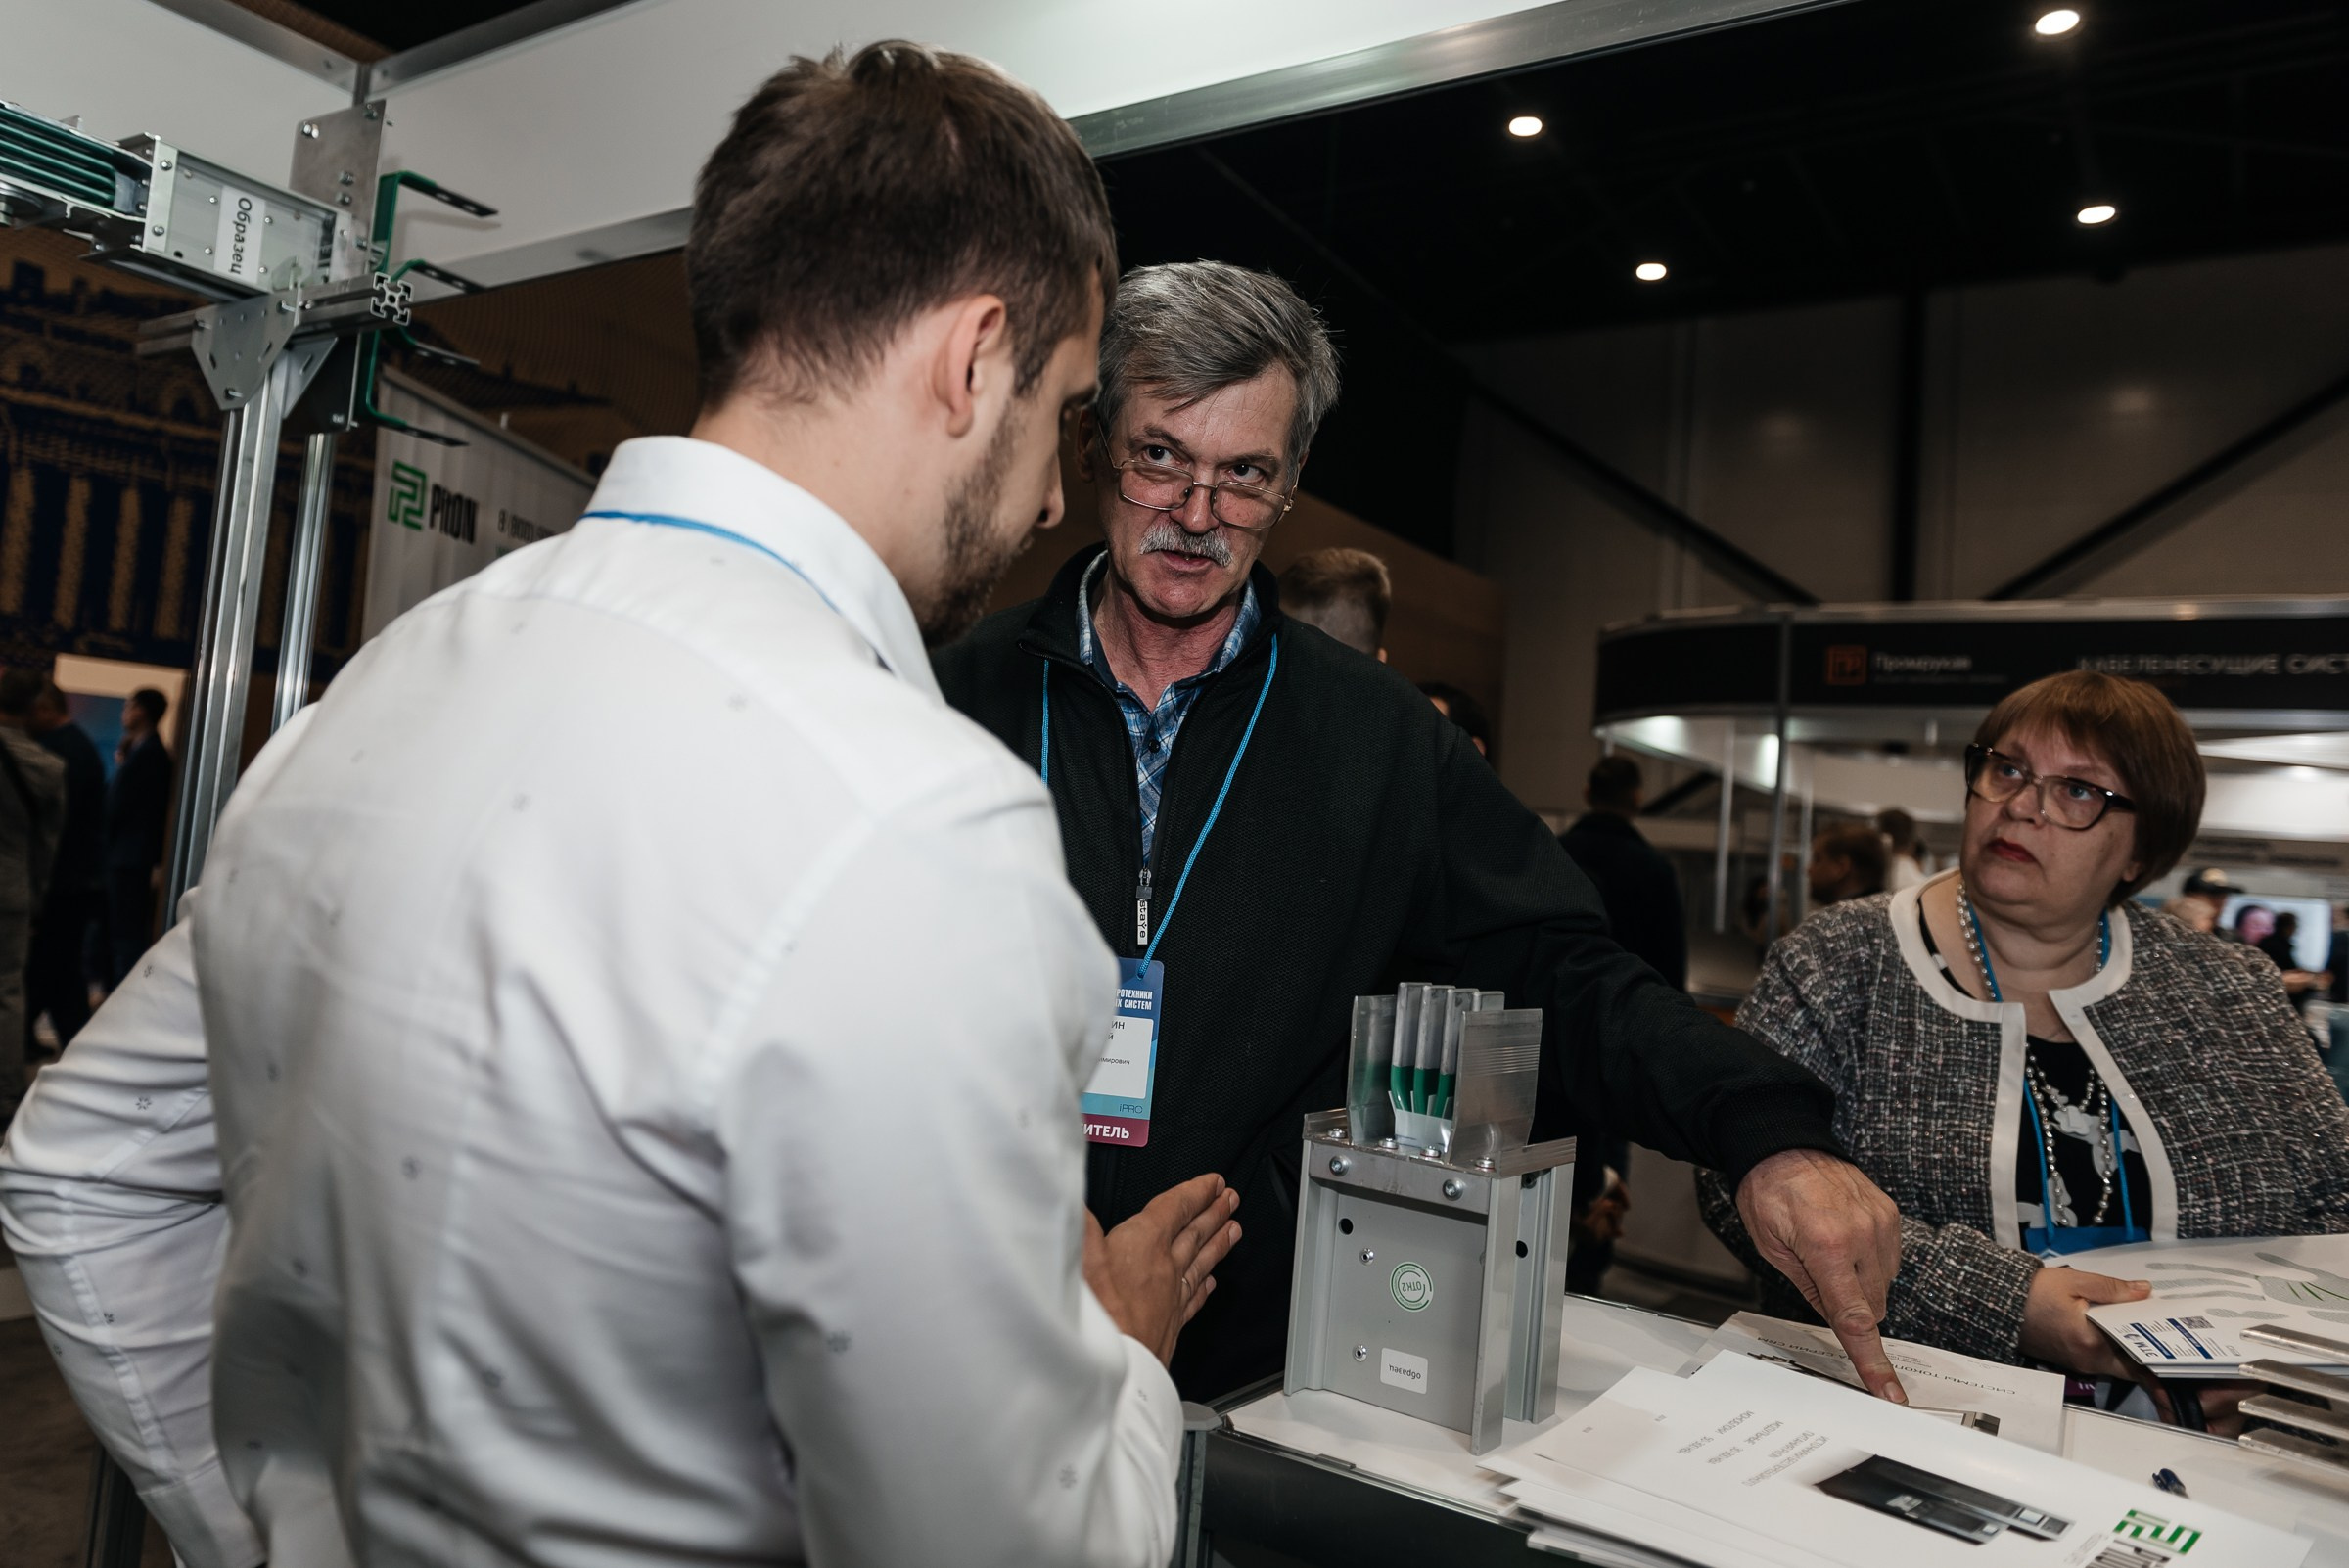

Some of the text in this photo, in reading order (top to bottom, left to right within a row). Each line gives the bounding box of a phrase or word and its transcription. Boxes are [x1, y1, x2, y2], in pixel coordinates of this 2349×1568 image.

[228, 197, 253, 275] Образец
[1116, 989, 1153, 1000] РОТЕХНИКИ
[1124, 999, 1152, 1011] СИСТЕМ
[1082, 1123, 1129, 1139] ИТЕЛЬ
[1789, 1344, 1834, 1357] СЕРИИ
[1389, 1363, 1421, 1380] образец
[1944, 1373, 2016, 1395] СИСТЕМЫ
